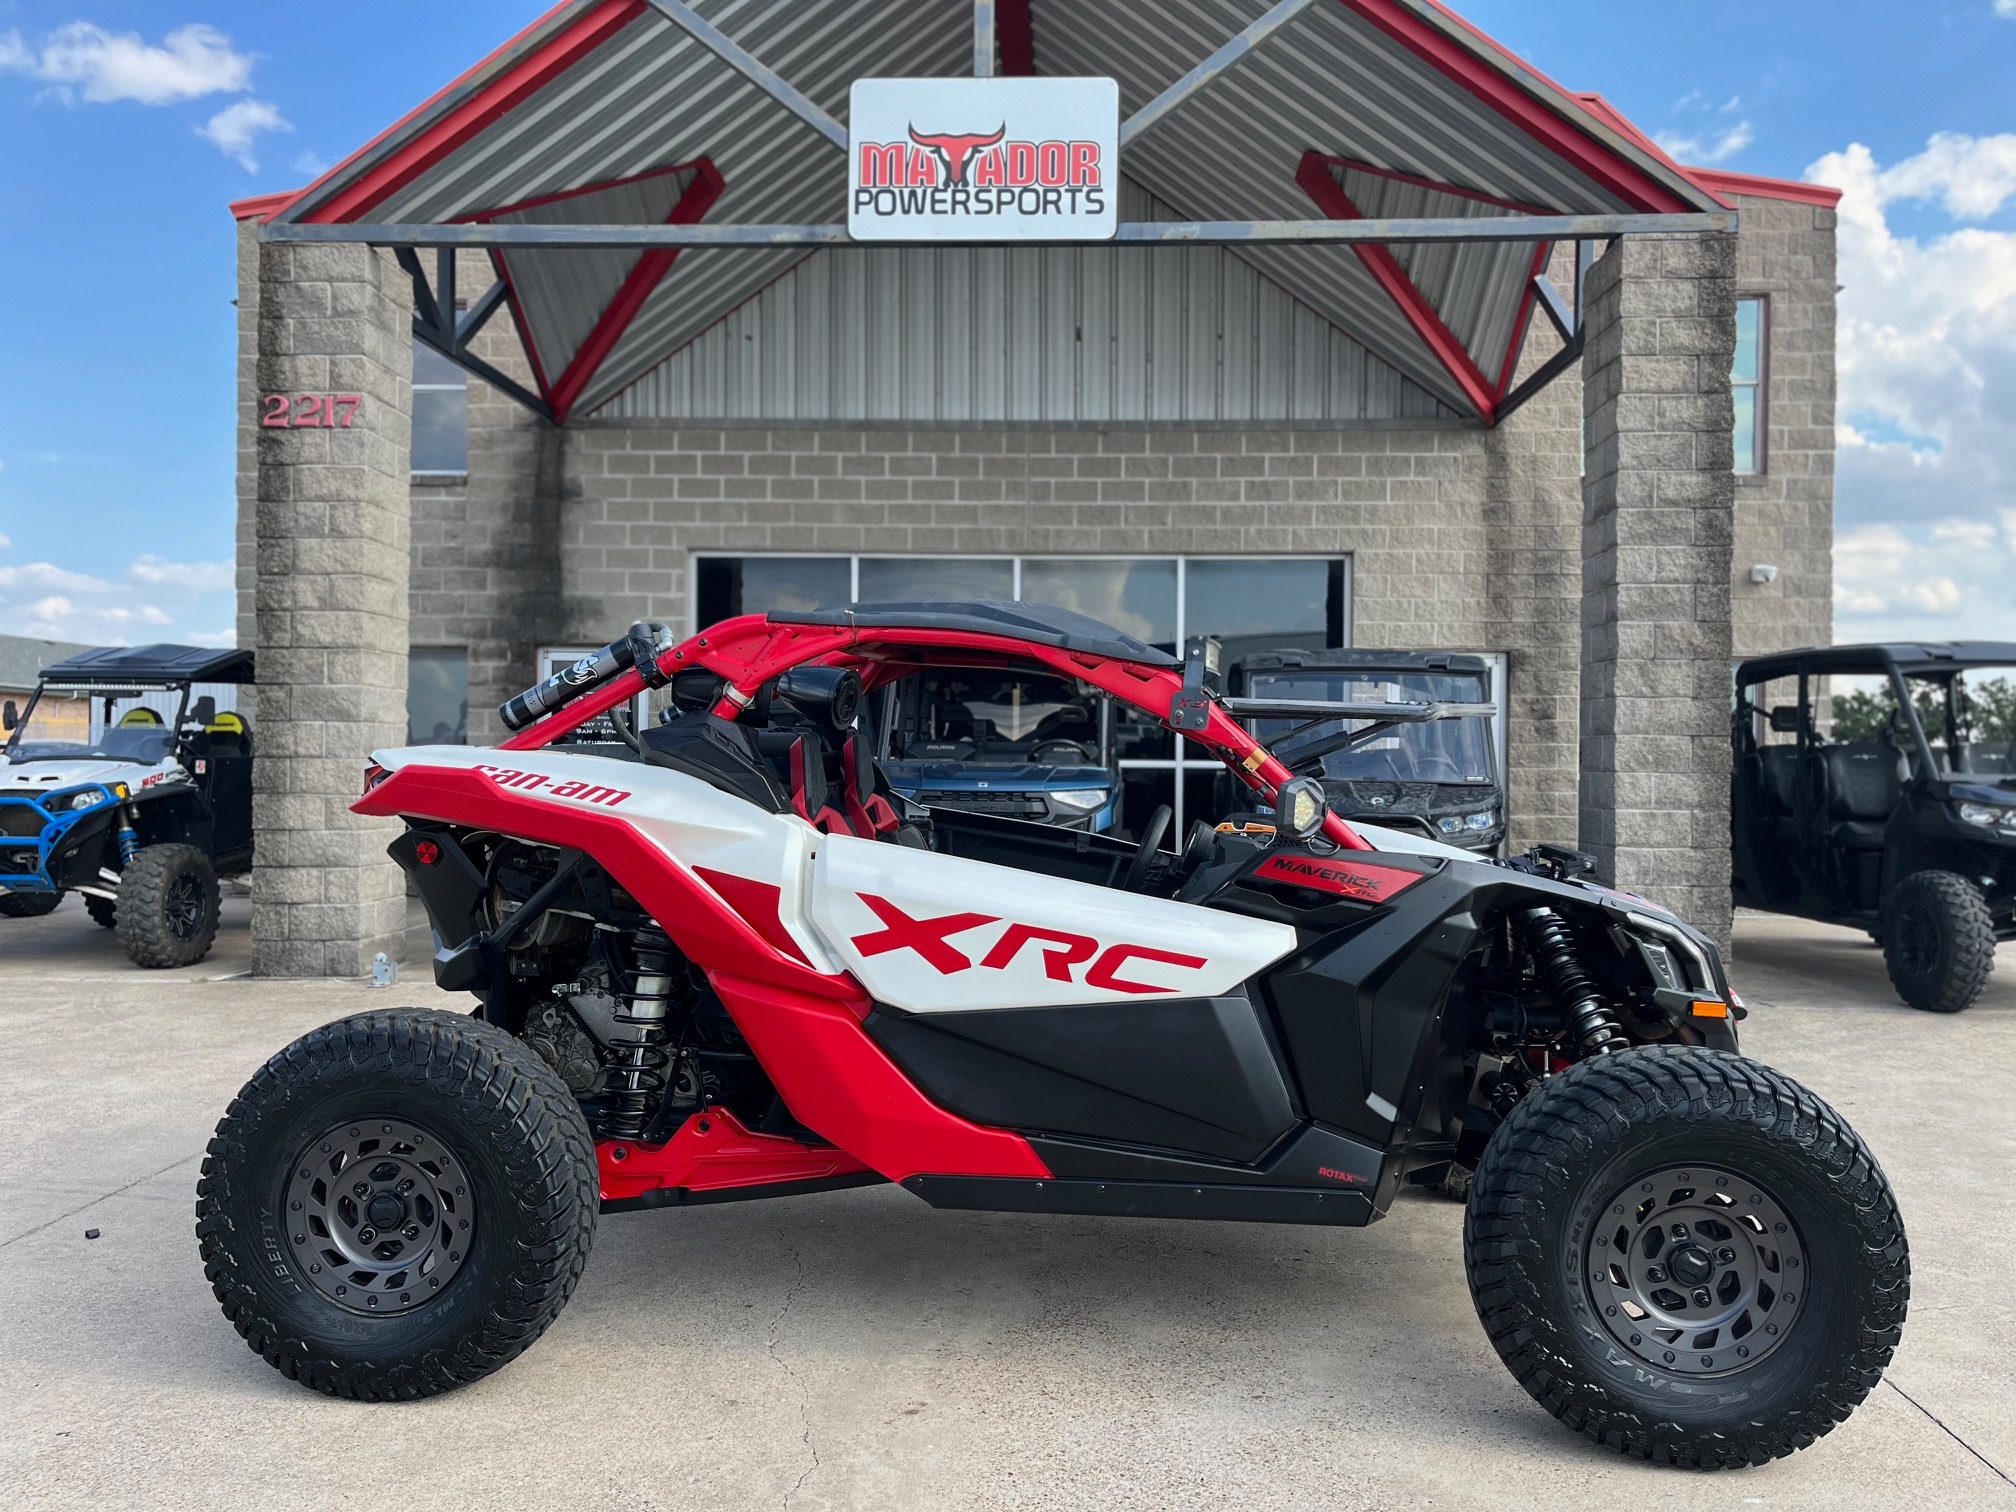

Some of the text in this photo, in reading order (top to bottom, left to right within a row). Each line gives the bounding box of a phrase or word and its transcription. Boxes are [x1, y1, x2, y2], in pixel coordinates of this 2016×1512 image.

[859, 121, 1102, 188] MATADOR
[854, 187, 1105, 217] POWERSPORTS
[262, 393, 362, 429] 2217
[1273, 857, 1383, 891] MAVERICK
[850, 891, 1209, 994] XRC
[1318, 1165, 1354, 1183] ROTAX
[259, 1205, 304, 1293] LIBERTY
